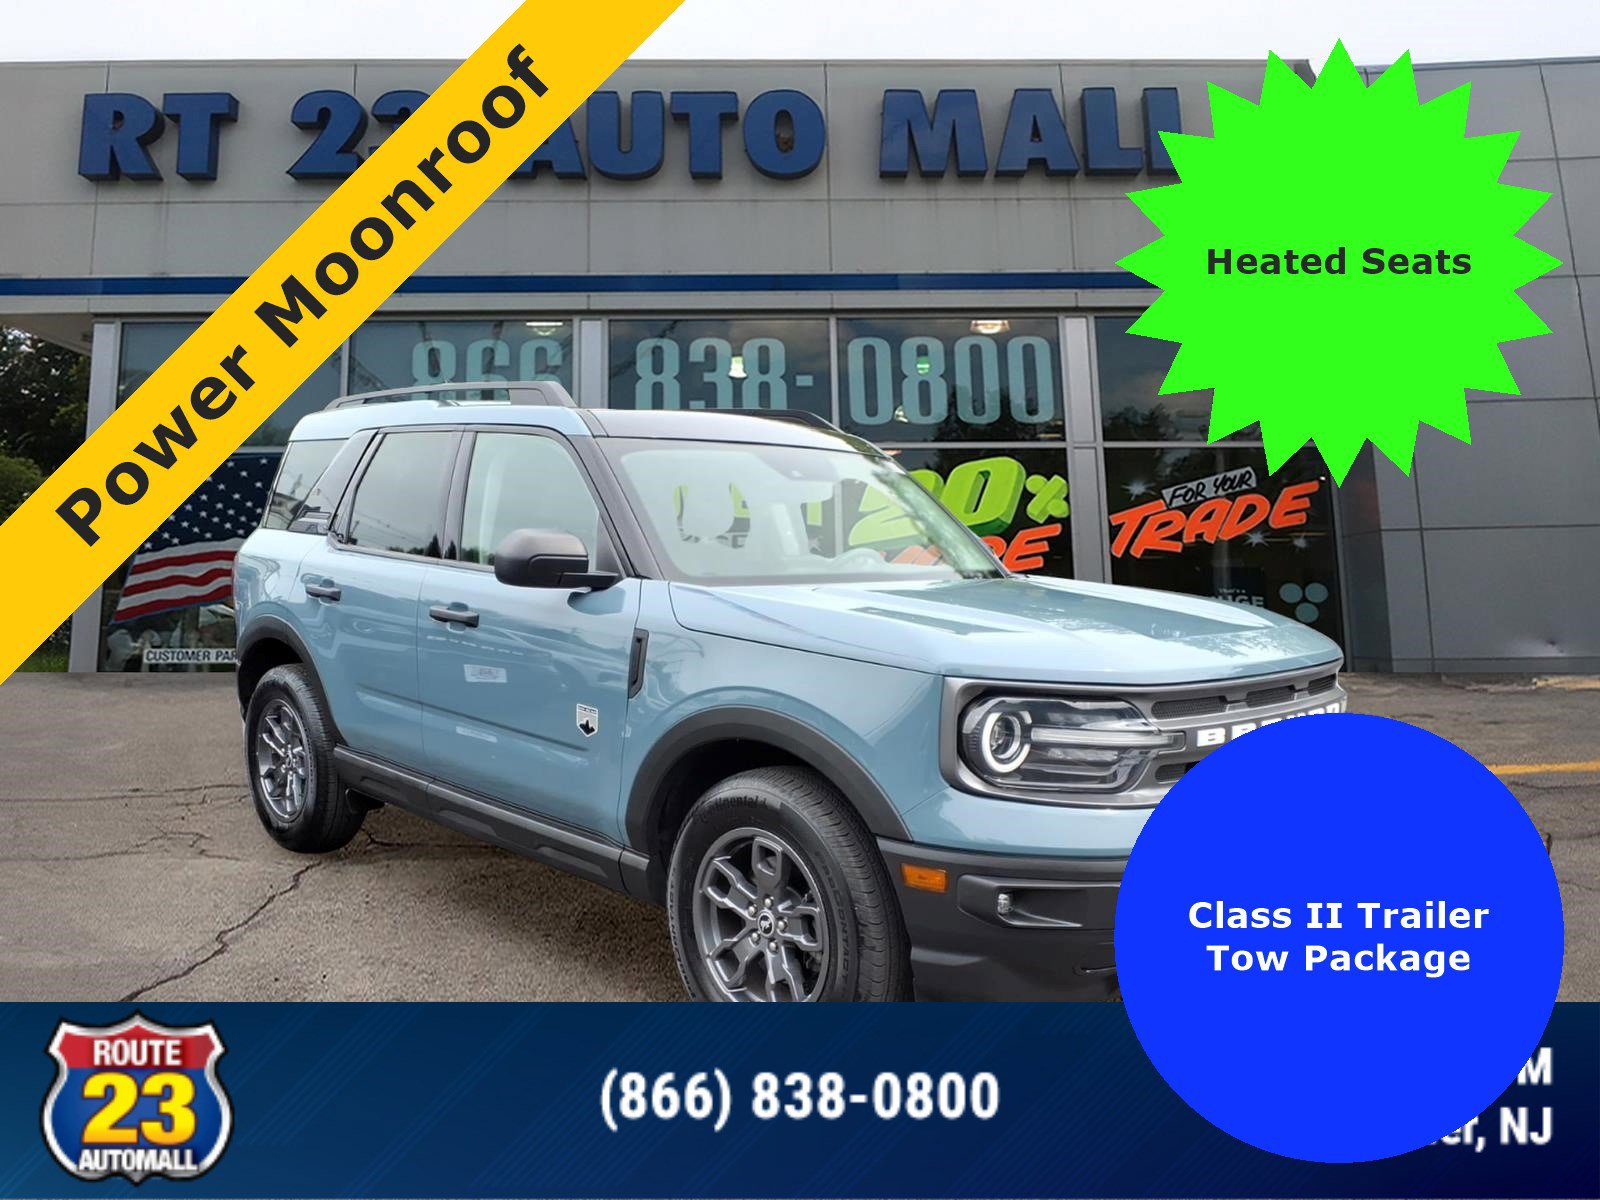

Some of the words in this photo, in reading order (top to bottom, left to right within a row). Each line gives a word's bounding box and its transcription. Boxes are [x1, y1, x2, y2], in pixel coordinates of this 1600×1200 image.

[78, 93, 239, 181] RT
[1167, 483, 1207, 507] FOR
[1213, 470, 1253, 494] YOUR
[1109, 480, 1320, 559] TRADE
[145, 650, 210, 661] CUSTOMER
